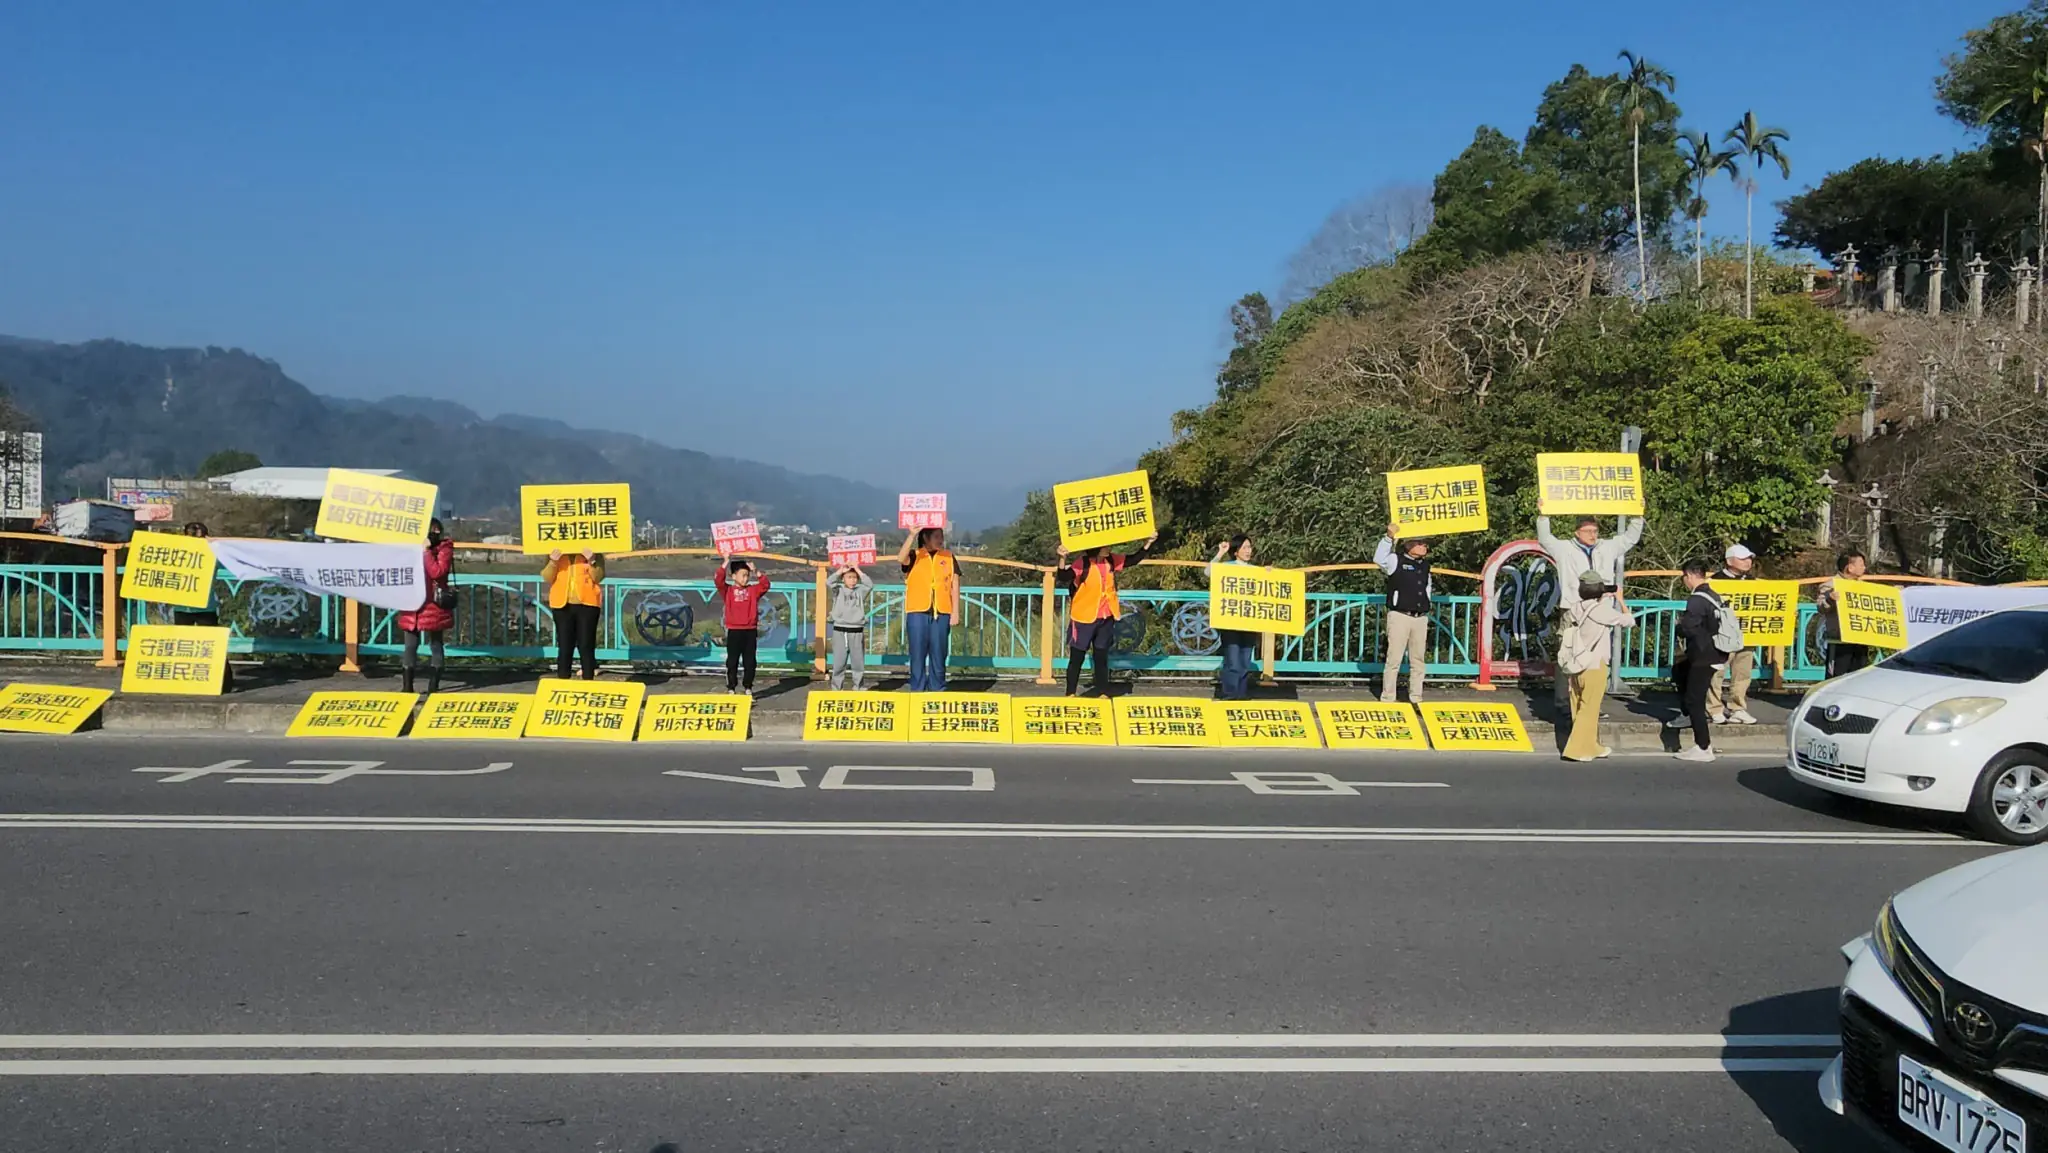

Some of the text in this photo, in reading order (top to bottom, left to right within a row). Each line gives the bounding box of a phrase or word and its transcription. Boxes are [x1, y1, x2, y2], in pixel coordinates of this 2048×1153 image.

[1545, 465, 1634, 482] 毒害大埔里
[1395, 480, 1478, 502] 毒害大埔里
[1546, 484, 1636, 501] 誓死拼到底
[536, 497, 618, 518] 毒害埔里
[1063, 485, 1146, 515] 毒害大埔里
[1398, 500, 1481, 523] 誓死拼到底
[1066, 507, 1148, 537] 誓死拼到底
[537, 521, 619, 542] 反對到底
[139, 544, 205, 569] 給我好水
[132, 567, 200, 593] 拒喝毒水
[1220, 576, 1293, 600] 保護水源
[1220, 598, 1292, 622] 捍衛家園
[1845, 591, 1898, 616] 駁回申請
[1738, 615, 1785, 634] 重民意
[1849, 612, 1901, 638] 皆大歡喜
[139, 637, 216, 659] 守護烏溪
[135, 660, 212, 683] 尊重民意
[316, 698, 400, 714] 錯誤選址
[435, 700, 521, 714] 選址錯誤
[548, 689, 630, 710] 不予審查
[817, 699, 895, 714] 保護水源
[657, 702, 738, 716] 不予審查
[921, 701, 999, 715] 選址錯誤
[1024, 705, 1102, 719] 守護烏溪
[1126, 704, 1205, 720] 選址錯誤
[1226, 708, 1302, 723] 駁回申請
[306, 714, 392, 729] 禍害不止
[427, 715, 514, 729] 走投無路
[815, 716, 894, 732] 捍衛家園
[1331, 709, 1408, 724] 駁回申請
[921, 717, 1000, 733] 走投無路
[1024, 720, 1103, 735] 尊重民意
[1129, 721, 1207, 737] 走投無路
[1231, 724, 1308, 739] 皆大歡喜
[1337, 725, 1414, 740] 皆大歡喜
[1442, 726, 1519, 742] 反對到底
